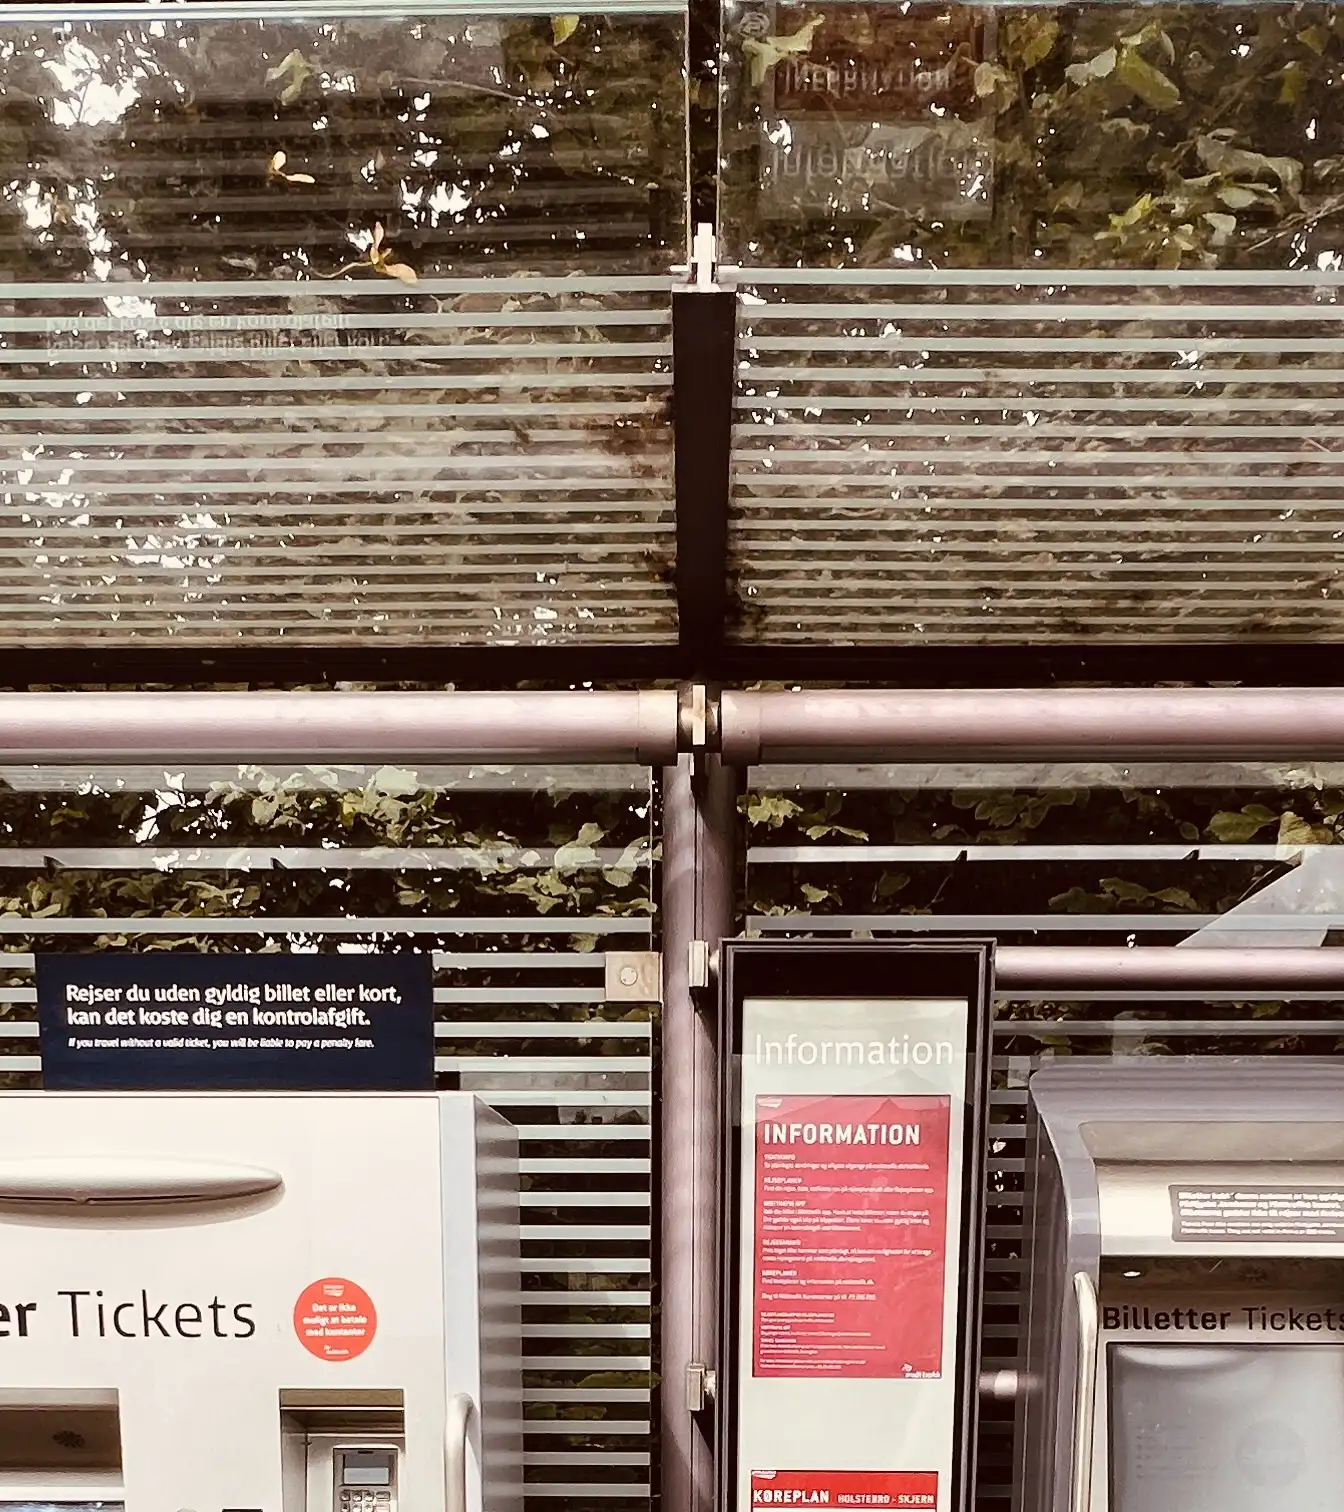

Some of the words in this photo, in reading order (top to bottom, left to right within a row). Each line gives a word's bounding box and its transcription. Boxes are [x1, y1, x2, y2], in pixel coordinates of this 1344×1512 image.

[66, 984, 122, 1005] Rejser
[126, 984, 150, 1001] du
[155, 984, 200, 1002] uden
[205, 984, 260, 1006] gyldig
[265, 984, 310, 1002] billet
[314, 984, 355, 1002] eller
[359, 984, 401, 1004] kort,
[67, 1008, 101, 1025] kan
[105, 1008, 136, 1025] det
[139, 1008, 188, 1025] koste
[192, 1008, 222, 1028] dig
[226, 1012, 248, 1025] en
[253, 1008, 370, 1029] kontrolafgift.
[76, 1039, 93, 1049] you
[120, 1038, 154, 1047] without
[162, 1038, 184, 1047] valid
[212, 1039, 229, 1049] you
[231, 1038, 246, 1047] will
[247, 1038, 259, 1047] be
[260, 1038, 283, 1047] liable
[284, 1038, 294, 1047] to
[295, 1039, 312, 1049] pay
[320, 1038, 353, 1049] penalty
[756, 1033, 953, 1065] Information
[764, 1123, 920, 1145] INFORMATION
[57, 1290, 256, 1339] Tickets
[1102, 1305, 1231, 1330] Billetter
[753, 1489, 829, 1503] KØREPLAN
[837, 1494, 890, 1504] HOLSTEBRO
[898, 1494, 934, 1504] SKJERN
